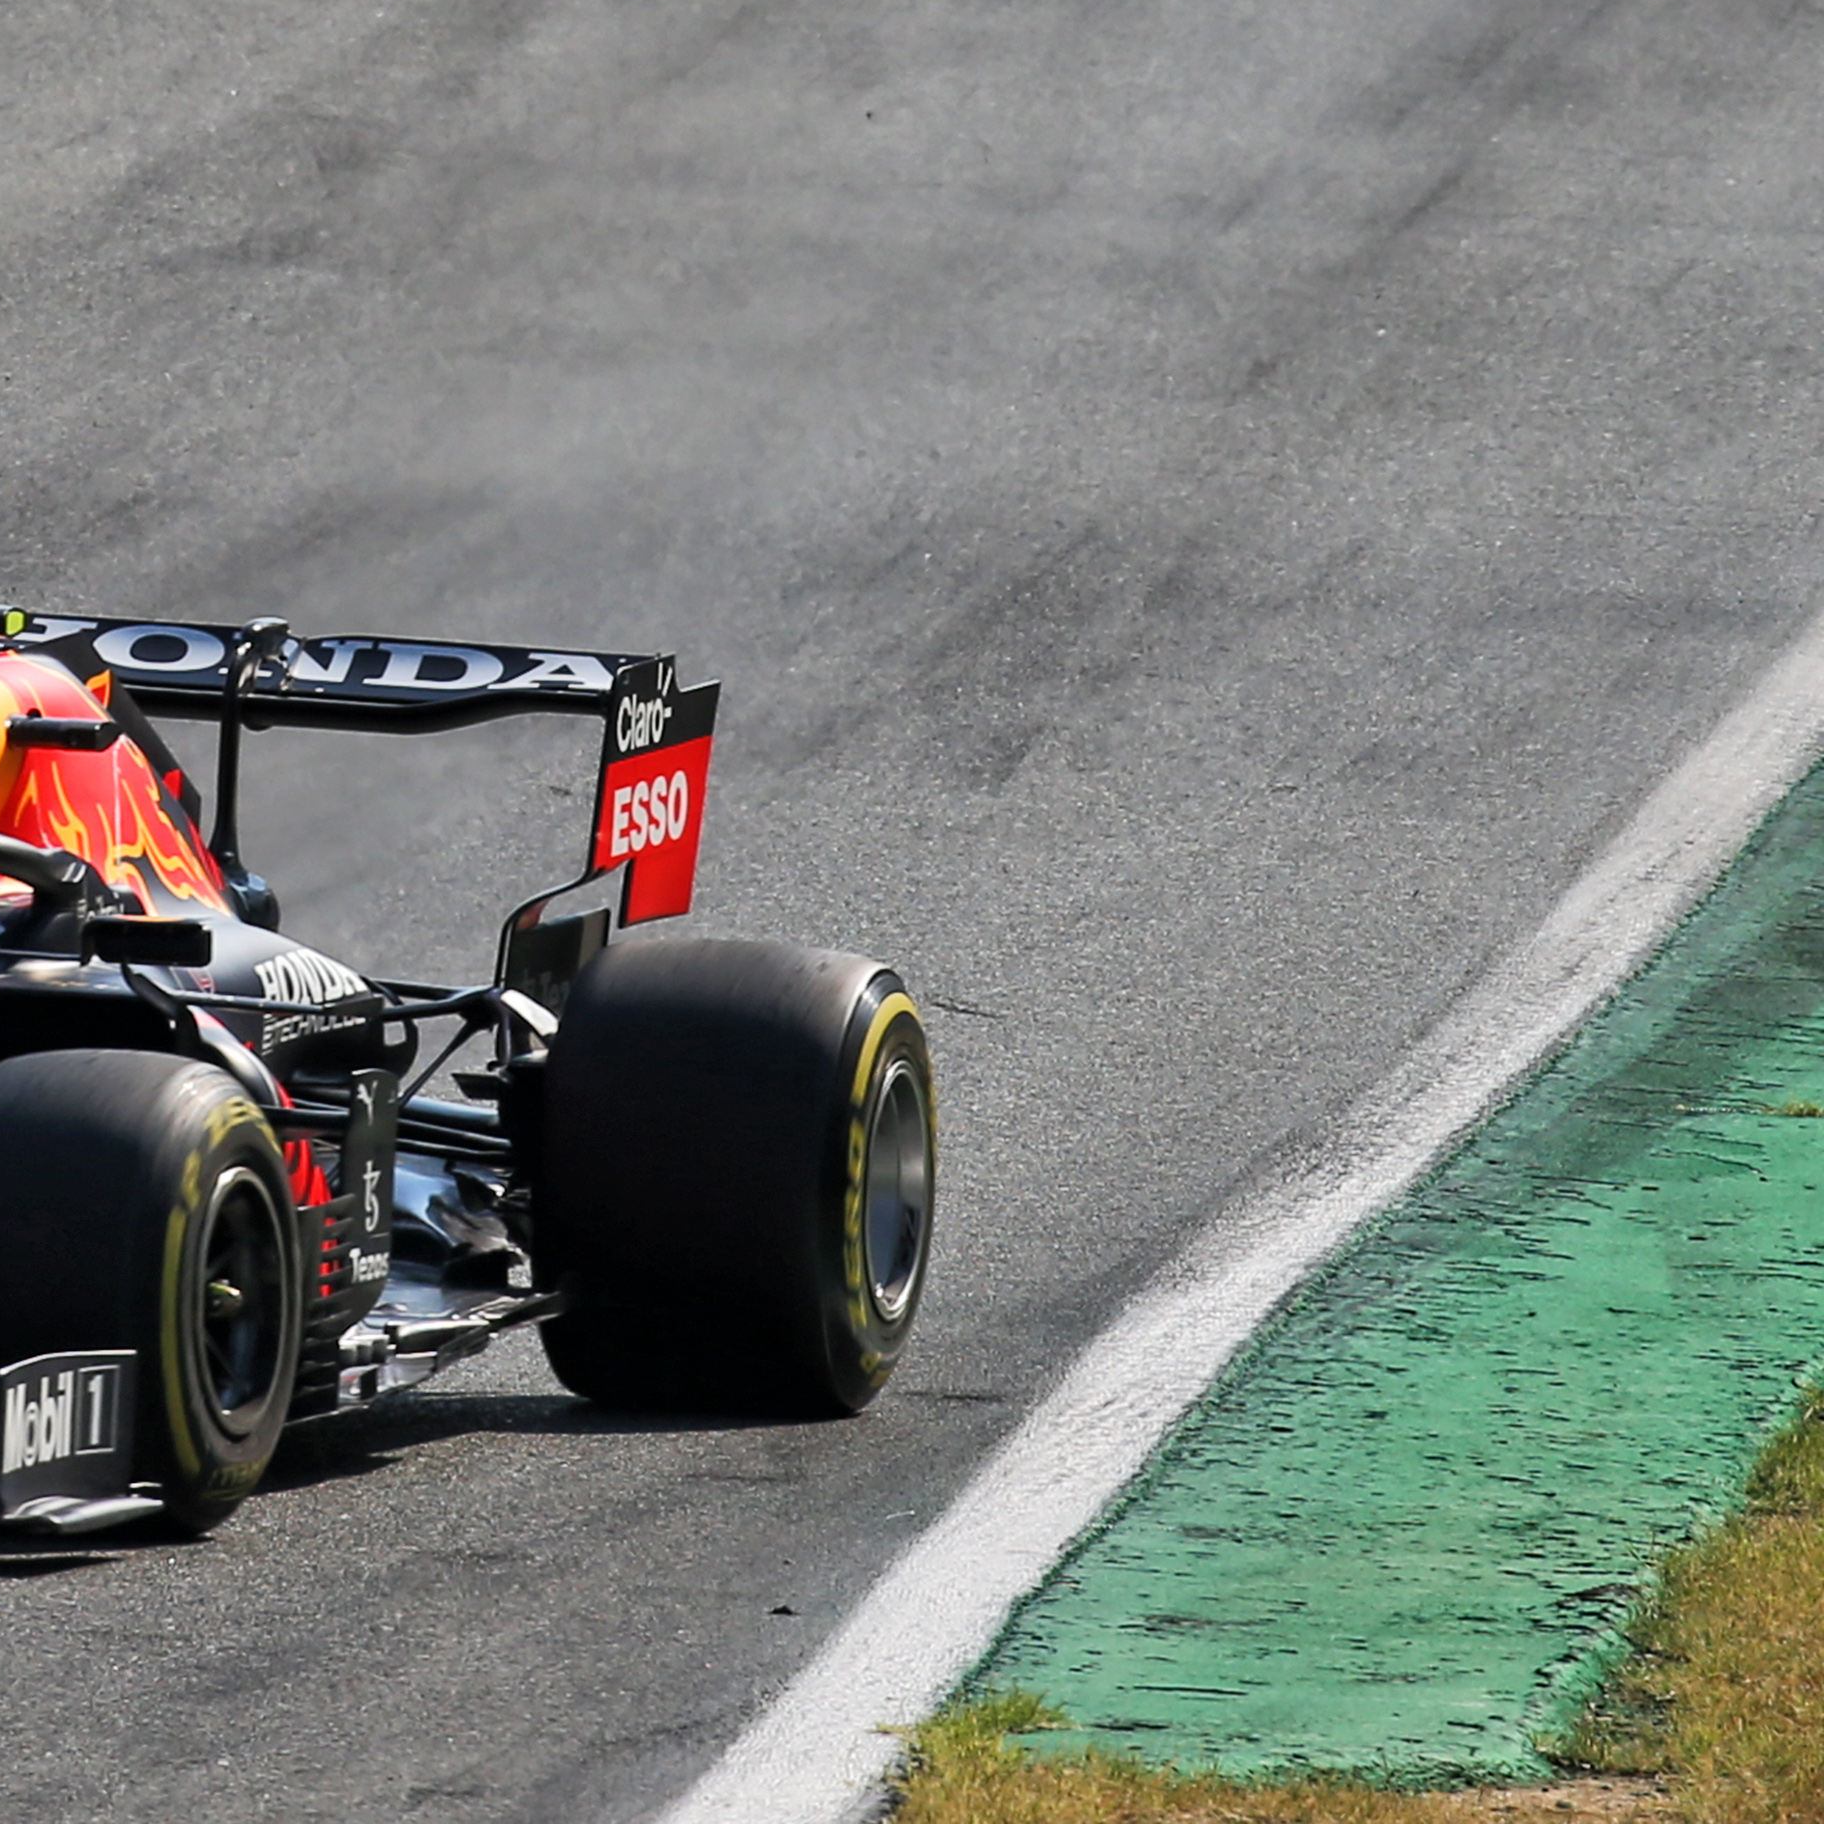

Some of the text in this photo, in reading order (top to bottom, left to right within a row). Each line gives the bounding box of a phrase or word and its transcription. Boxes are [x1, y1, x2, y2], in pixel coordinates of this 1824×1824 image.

[616, 692, 664, 753] Claro
[610, 769, 688, 858] ESSO
[254, 948, 369, 1005] HONDA
[350, 1247, 391, 1283] Tezos
[2, 1370, 75, 1474] Mobil
